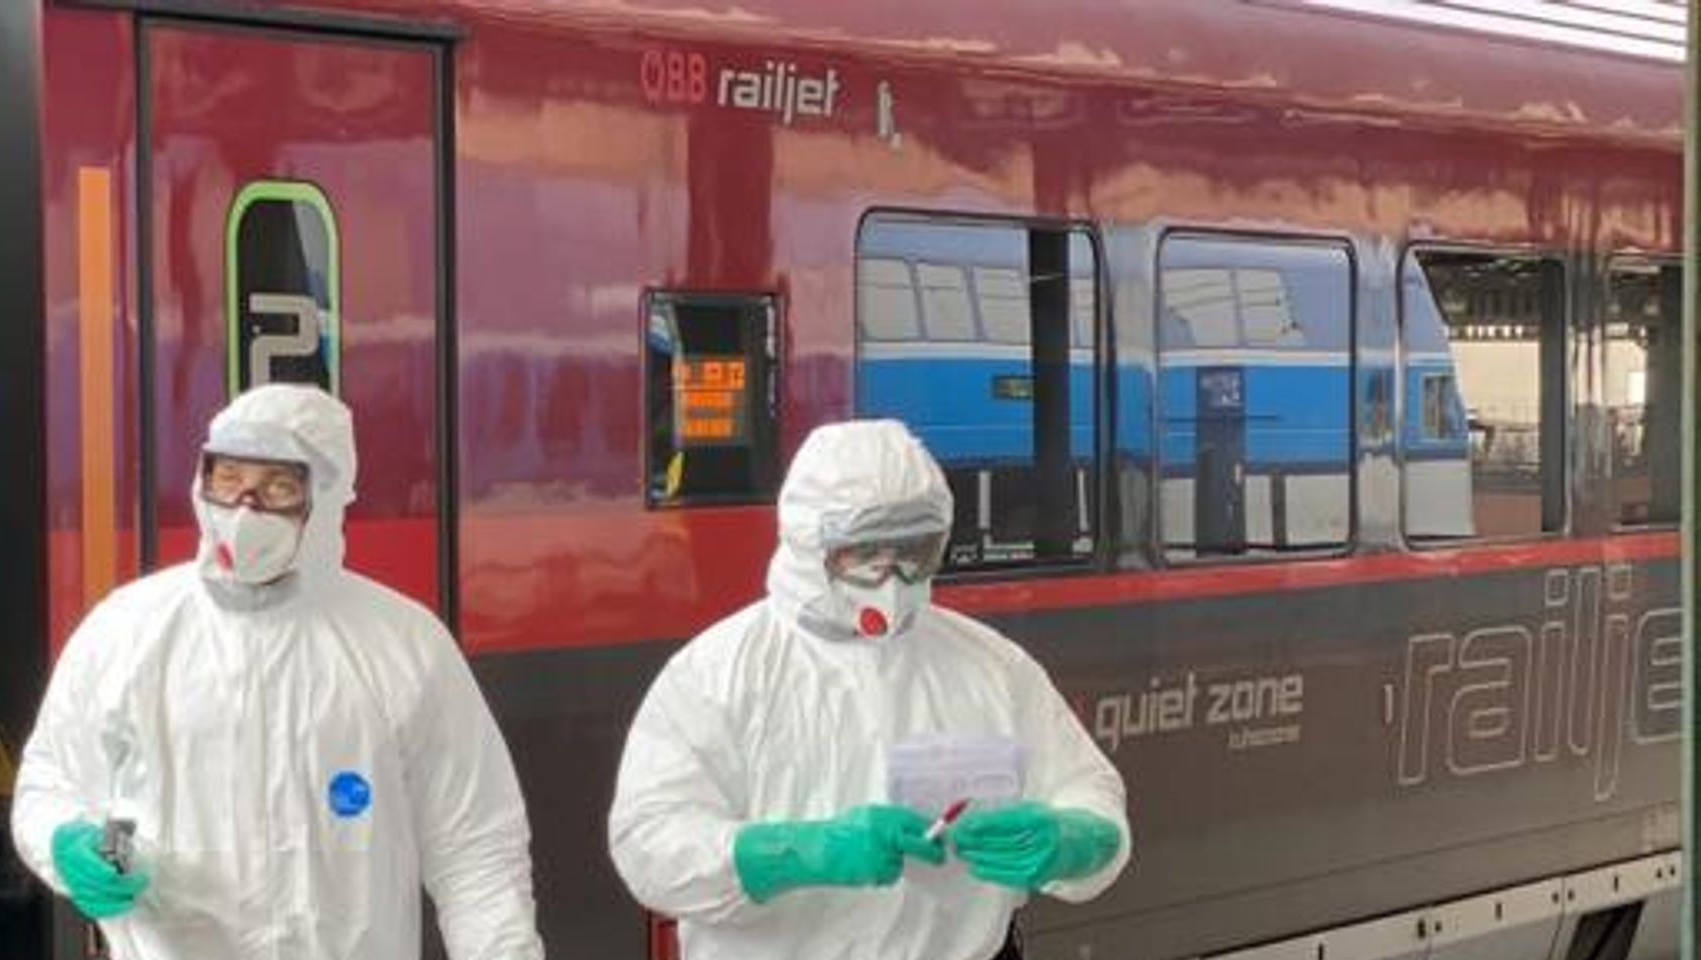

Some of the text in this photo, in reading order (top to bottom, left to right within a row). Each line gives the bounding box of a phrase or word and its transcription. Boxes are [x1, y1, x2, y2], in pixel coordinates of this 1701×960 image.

[717, 60, 840, 125] railjet
[1096, 672, 1303, 749] quiet zone
